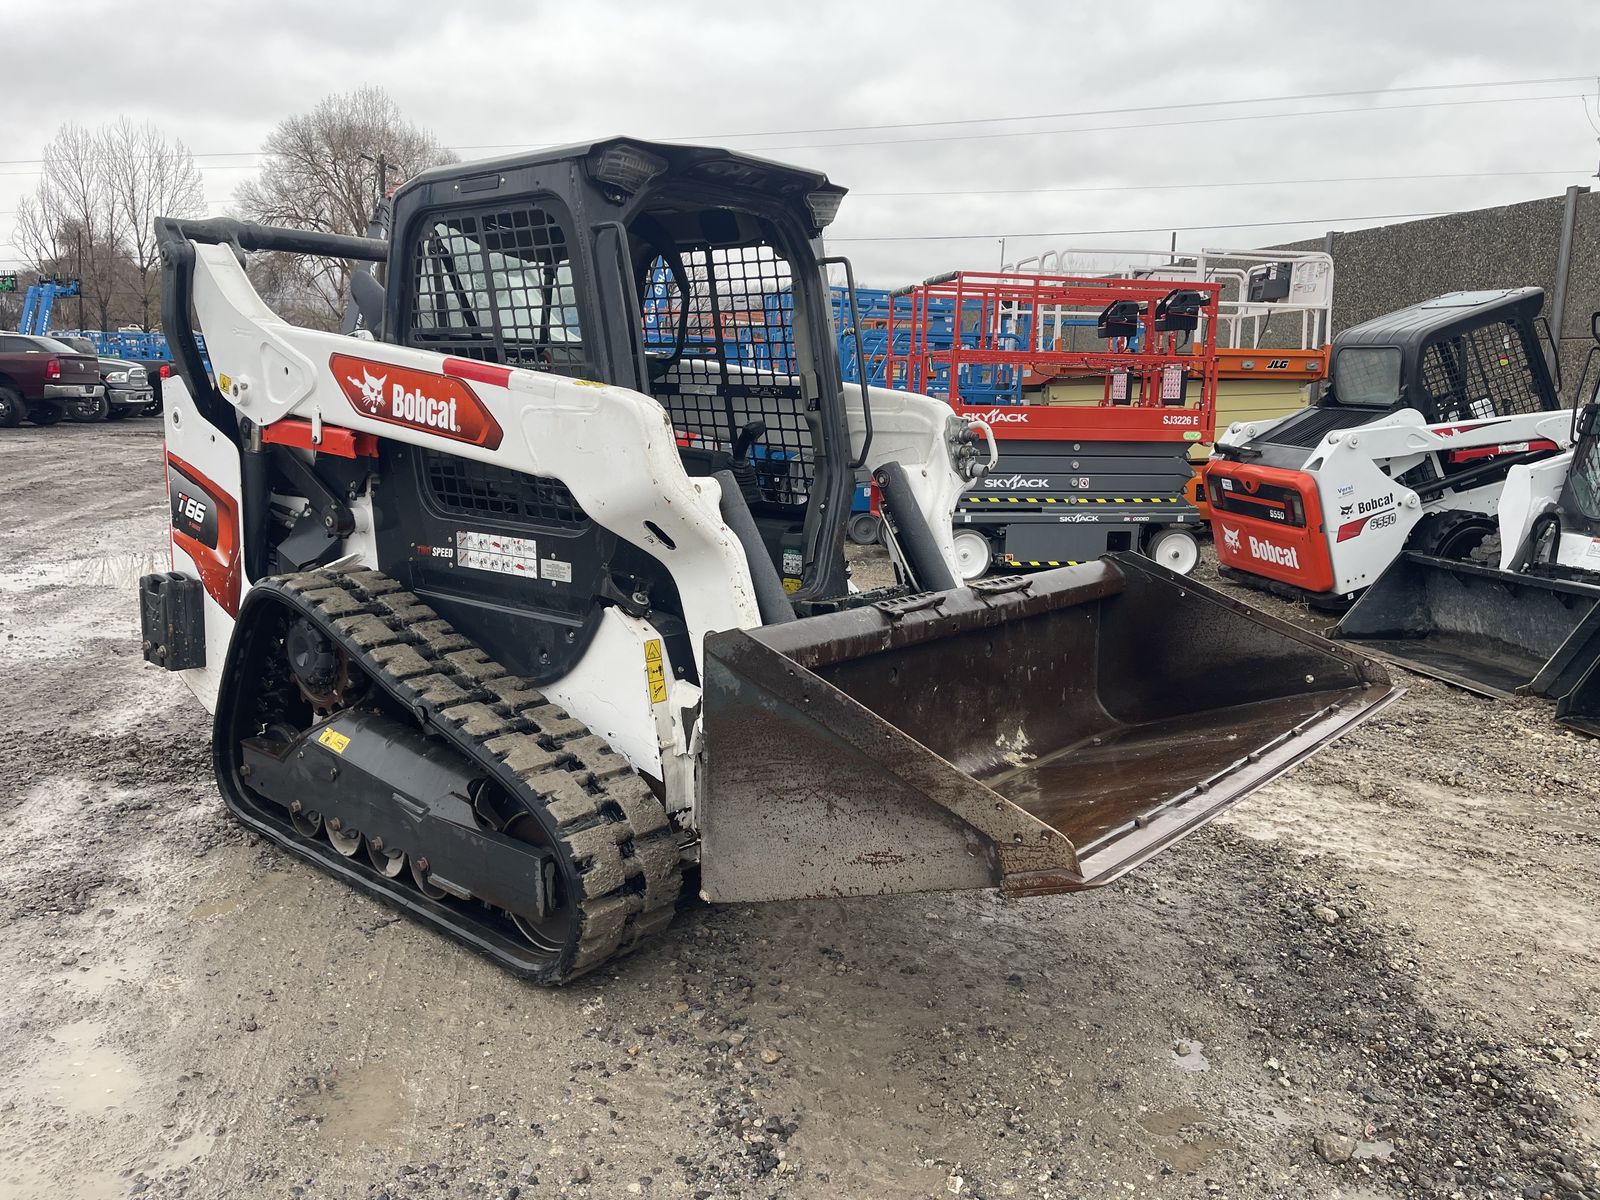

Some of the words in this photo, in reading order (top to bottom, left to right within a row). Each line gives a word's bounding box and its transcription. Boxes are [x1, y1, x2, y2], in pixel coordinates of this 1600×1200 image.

[1266, 359, 1290, 369] JLG
[392, 383, 457, 432] Bobcat
[962, 408, 1029, 424] SKYJACK
[1163, 415, 1192, 425] SJ3226
[1193, 416, 1199, 425] E
[984, 474, 1050, 490] SKYJACK
[178, 492, 207, 524] T66
[1357, 492, 1394, 515] Bobcat
[1059, 513, 1100, 523] SKYJACK
[1269, 509, 1285, 520] S550
[1370, 512, 1397, 531] S550
[432, 546, 453, 558] SPEED
[1248, 535, 1300, 570] Bobcat
